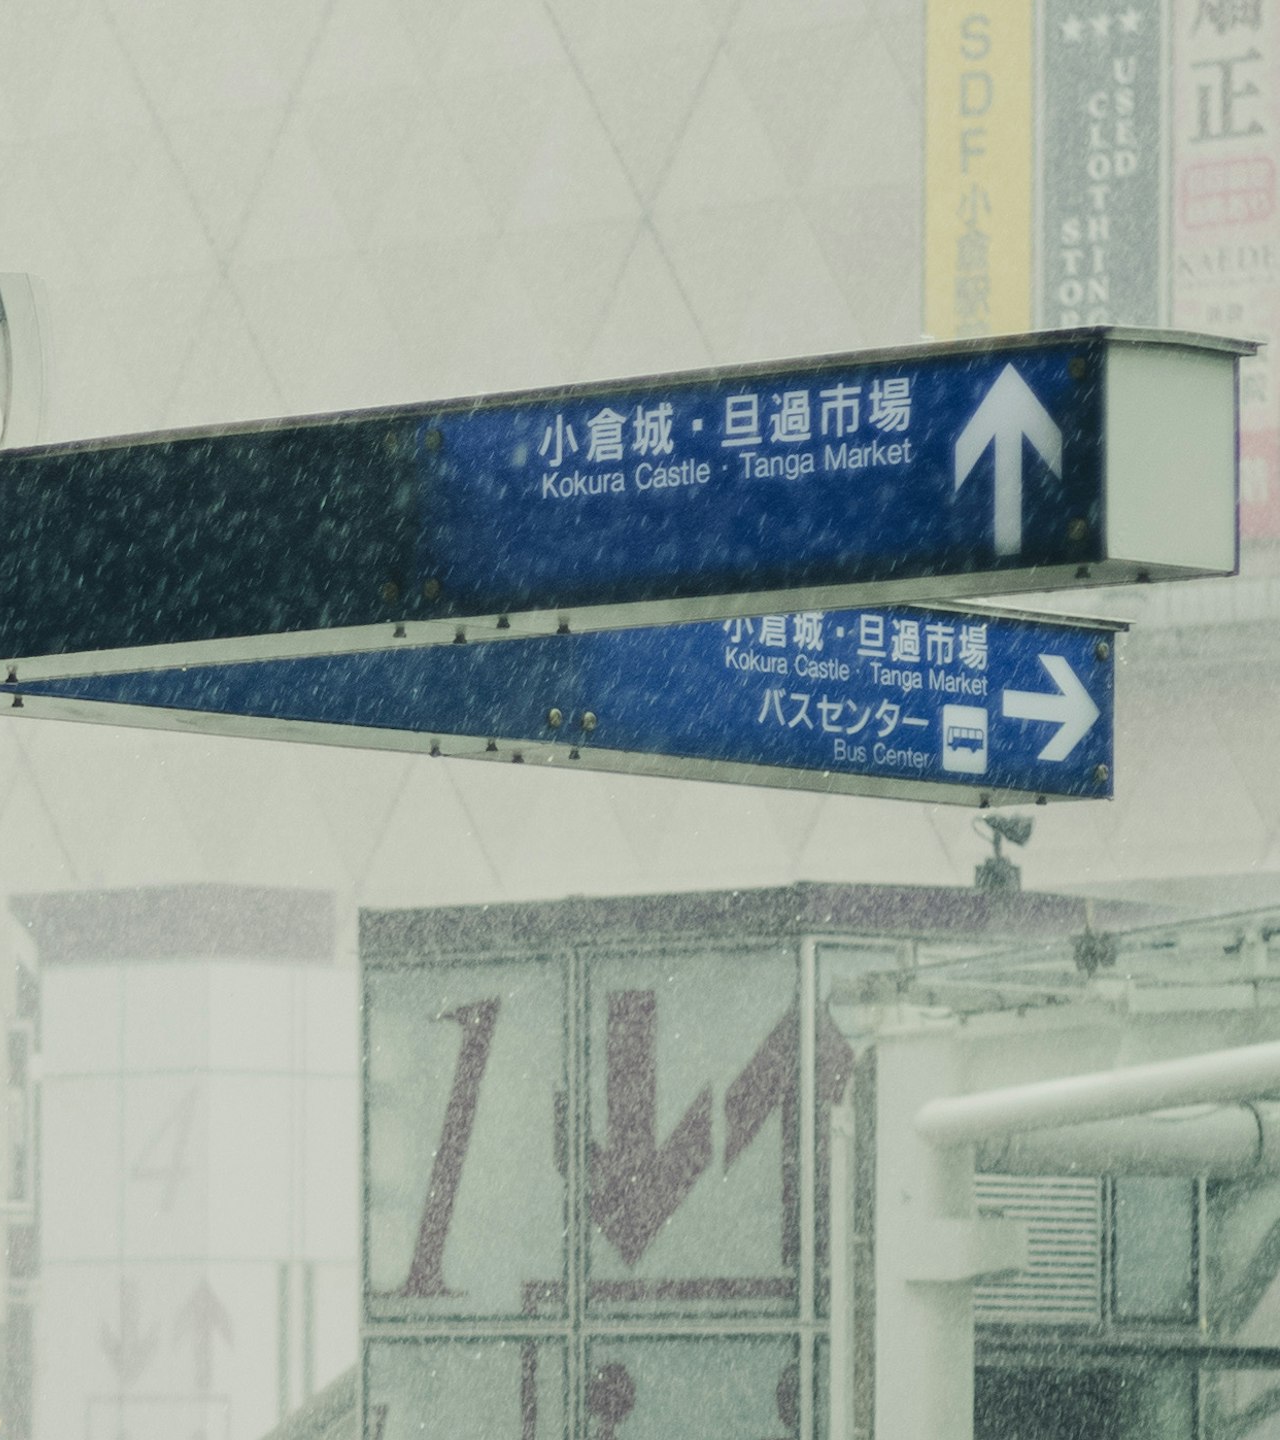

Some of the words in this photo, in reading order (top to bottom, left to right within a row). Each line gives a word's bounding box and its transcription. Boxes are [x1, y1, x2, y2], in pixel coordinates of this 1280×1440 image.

[1112, 56, 1139, 177] USED
[540, 376, 912, 468] 小倉城・旦過市場
[541, 471, 625, 499] Kokura
[635, 457, 711, 491] Castle
[740, 450, 815, 482] Tanga
[825, 439, 912, 471] Market
[725, 647, 788, 675] Kokura
[794, 654, 849, 682] Castle
[870, 662, 922, 693] Tanga
[929, 670, 989, 696] Market
[758, 688, 930, 738] バスセンター
[833, 739, 868, 763] Bus
[873, 744, 930, 769] Center
